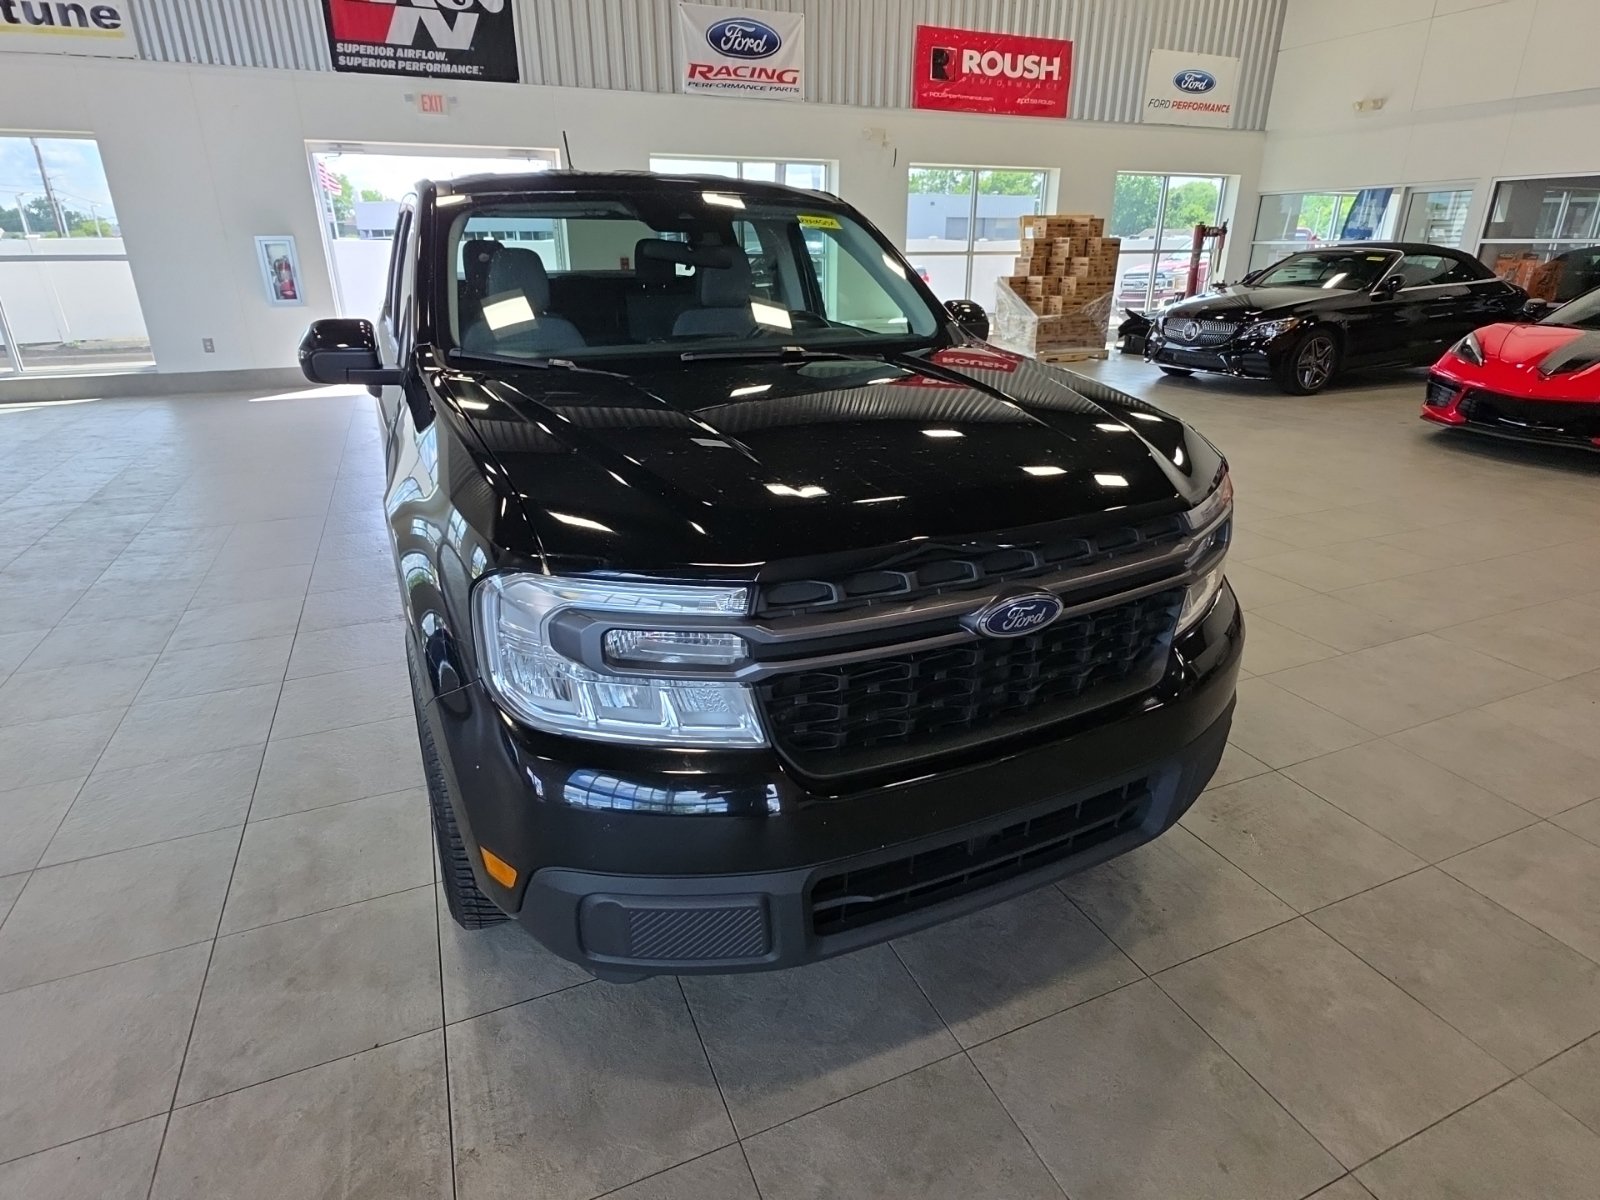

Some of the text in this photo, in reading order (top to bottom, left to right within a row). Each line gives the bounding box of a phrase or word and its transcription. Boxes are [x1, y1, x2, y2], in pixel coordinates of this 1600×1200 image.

[720, 23, 768, 53] Ford
[336, 43, 448, 61] SUPERIOR AIRFLOW.
[338, 55, 396, 69] SUPERIOR
[962, 48, 1061, 81] ROUSH
[687, 62, 800, 85] RACING
[1181, 72, 1208, 90] Ford
[687, 81, 767, 91] PERFORMANCE
[421, 94, 443, 112] EXIT
[1147, 98, 1231, 113] FORD PERFORMANCE
[1002, 604, 1046, 631] Ford
